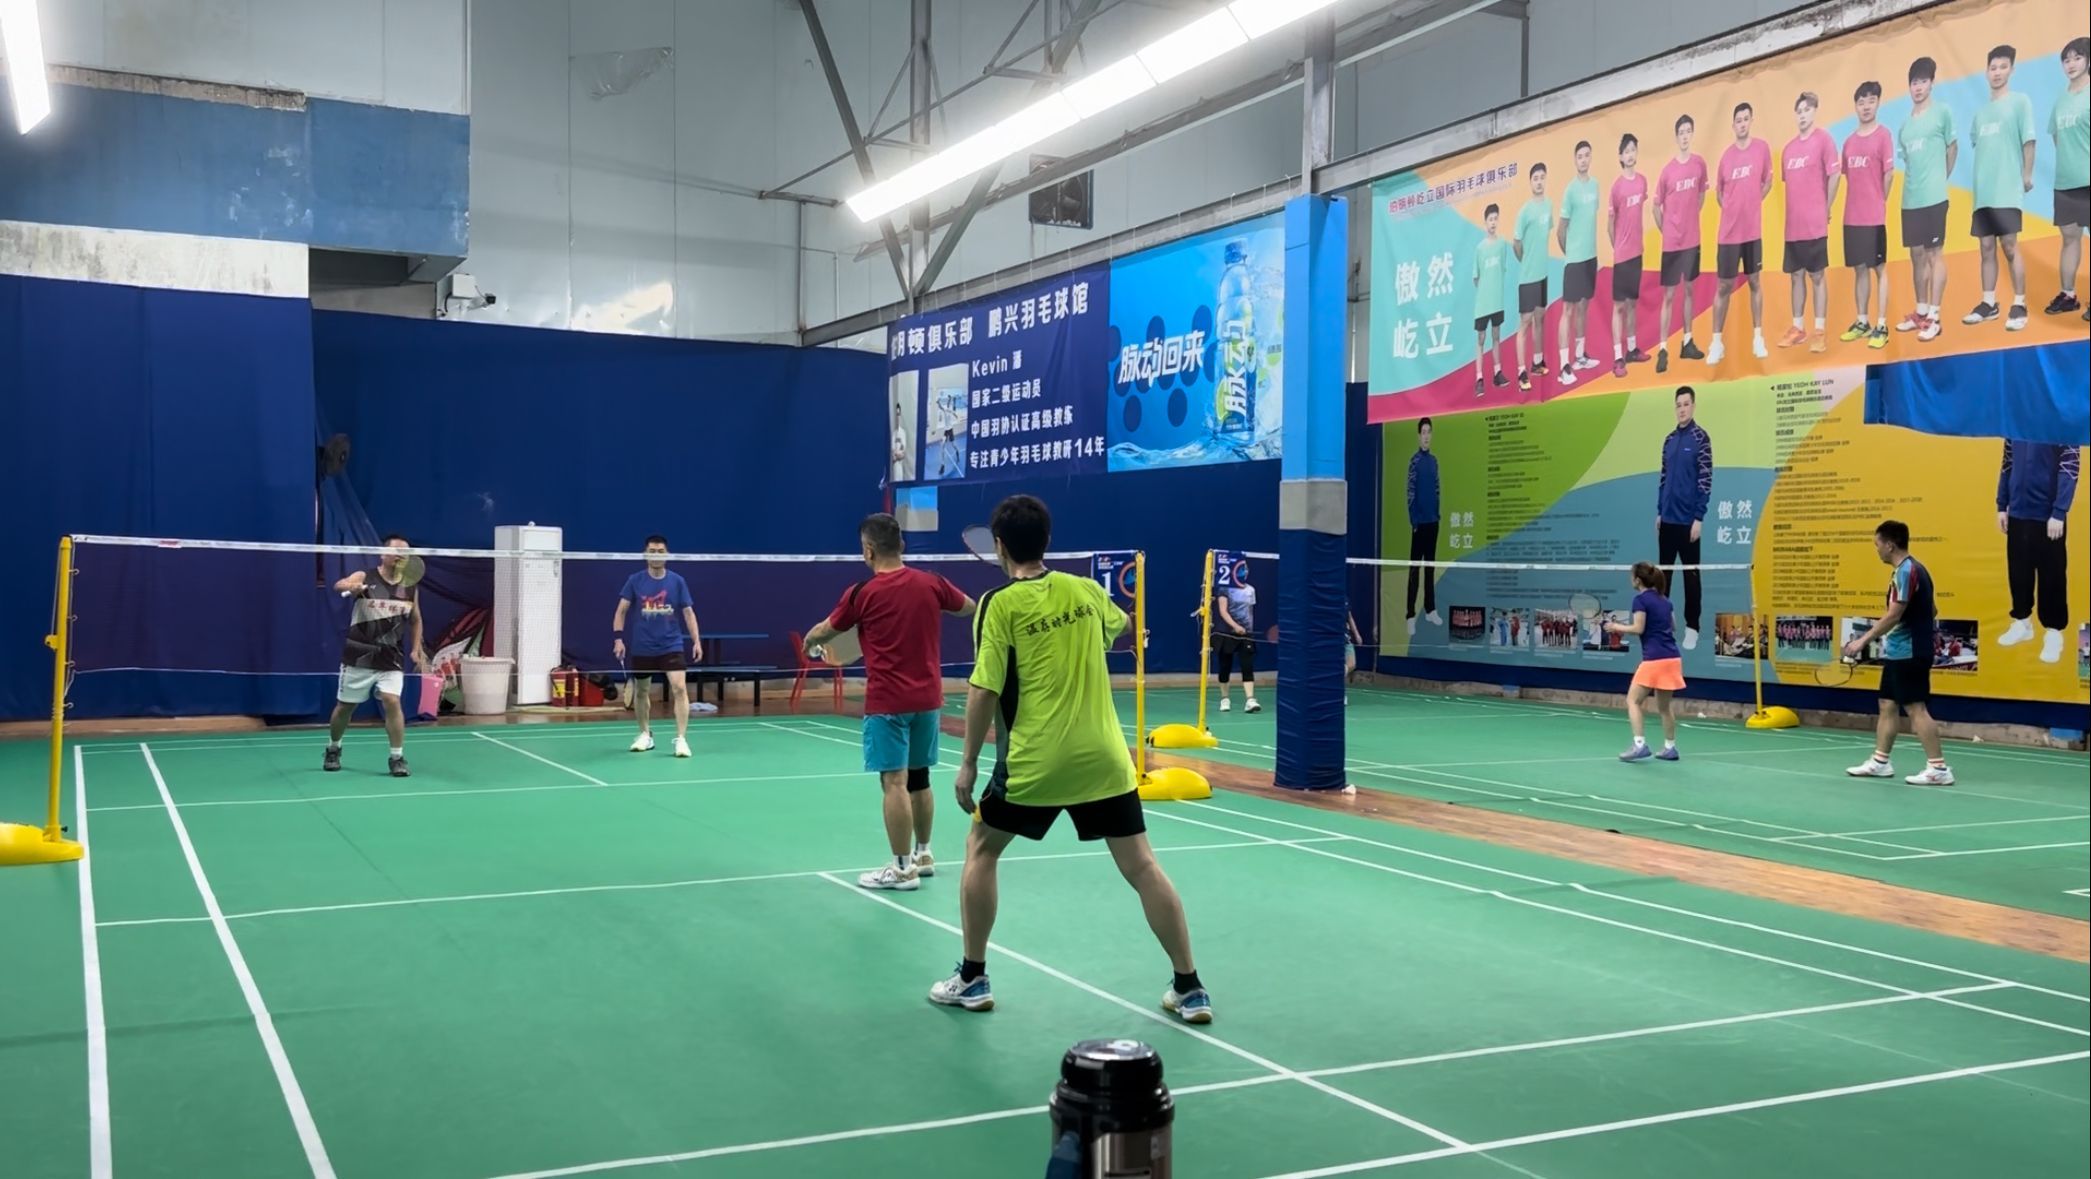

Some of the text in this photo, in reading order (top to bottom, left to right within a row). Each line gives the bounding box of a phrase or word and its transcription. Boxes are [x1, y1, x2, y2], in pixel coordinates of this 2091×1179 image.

[1731, 165, 1752, 180] EBC
[1787, 156, 1809, 169] EBC
[1847, 155, 1871, 168] EBC
[1675, 177, 1697, 192] EBC
[1394, 252, 1454, 306] 傲然
[988, 282, 1089, 338] 鹏兴羽毛球馆
[1393, 312, 1454, 359] 屹立
[972, 355, 1008, 378] Kevin
[1118, 330, 1206, 388] 脉动回来
[971, 378, 1041, 409] 国家二级运动员
[970, 405, 1073, 439] 中国羽协认证高级教练
[1717, 499, 1753, 520] 傲然
[1717, 525, 1753, 545] 屹立
[1101, 571, 1115, 597] 1
[1218, 565, 1230, 585] 2
